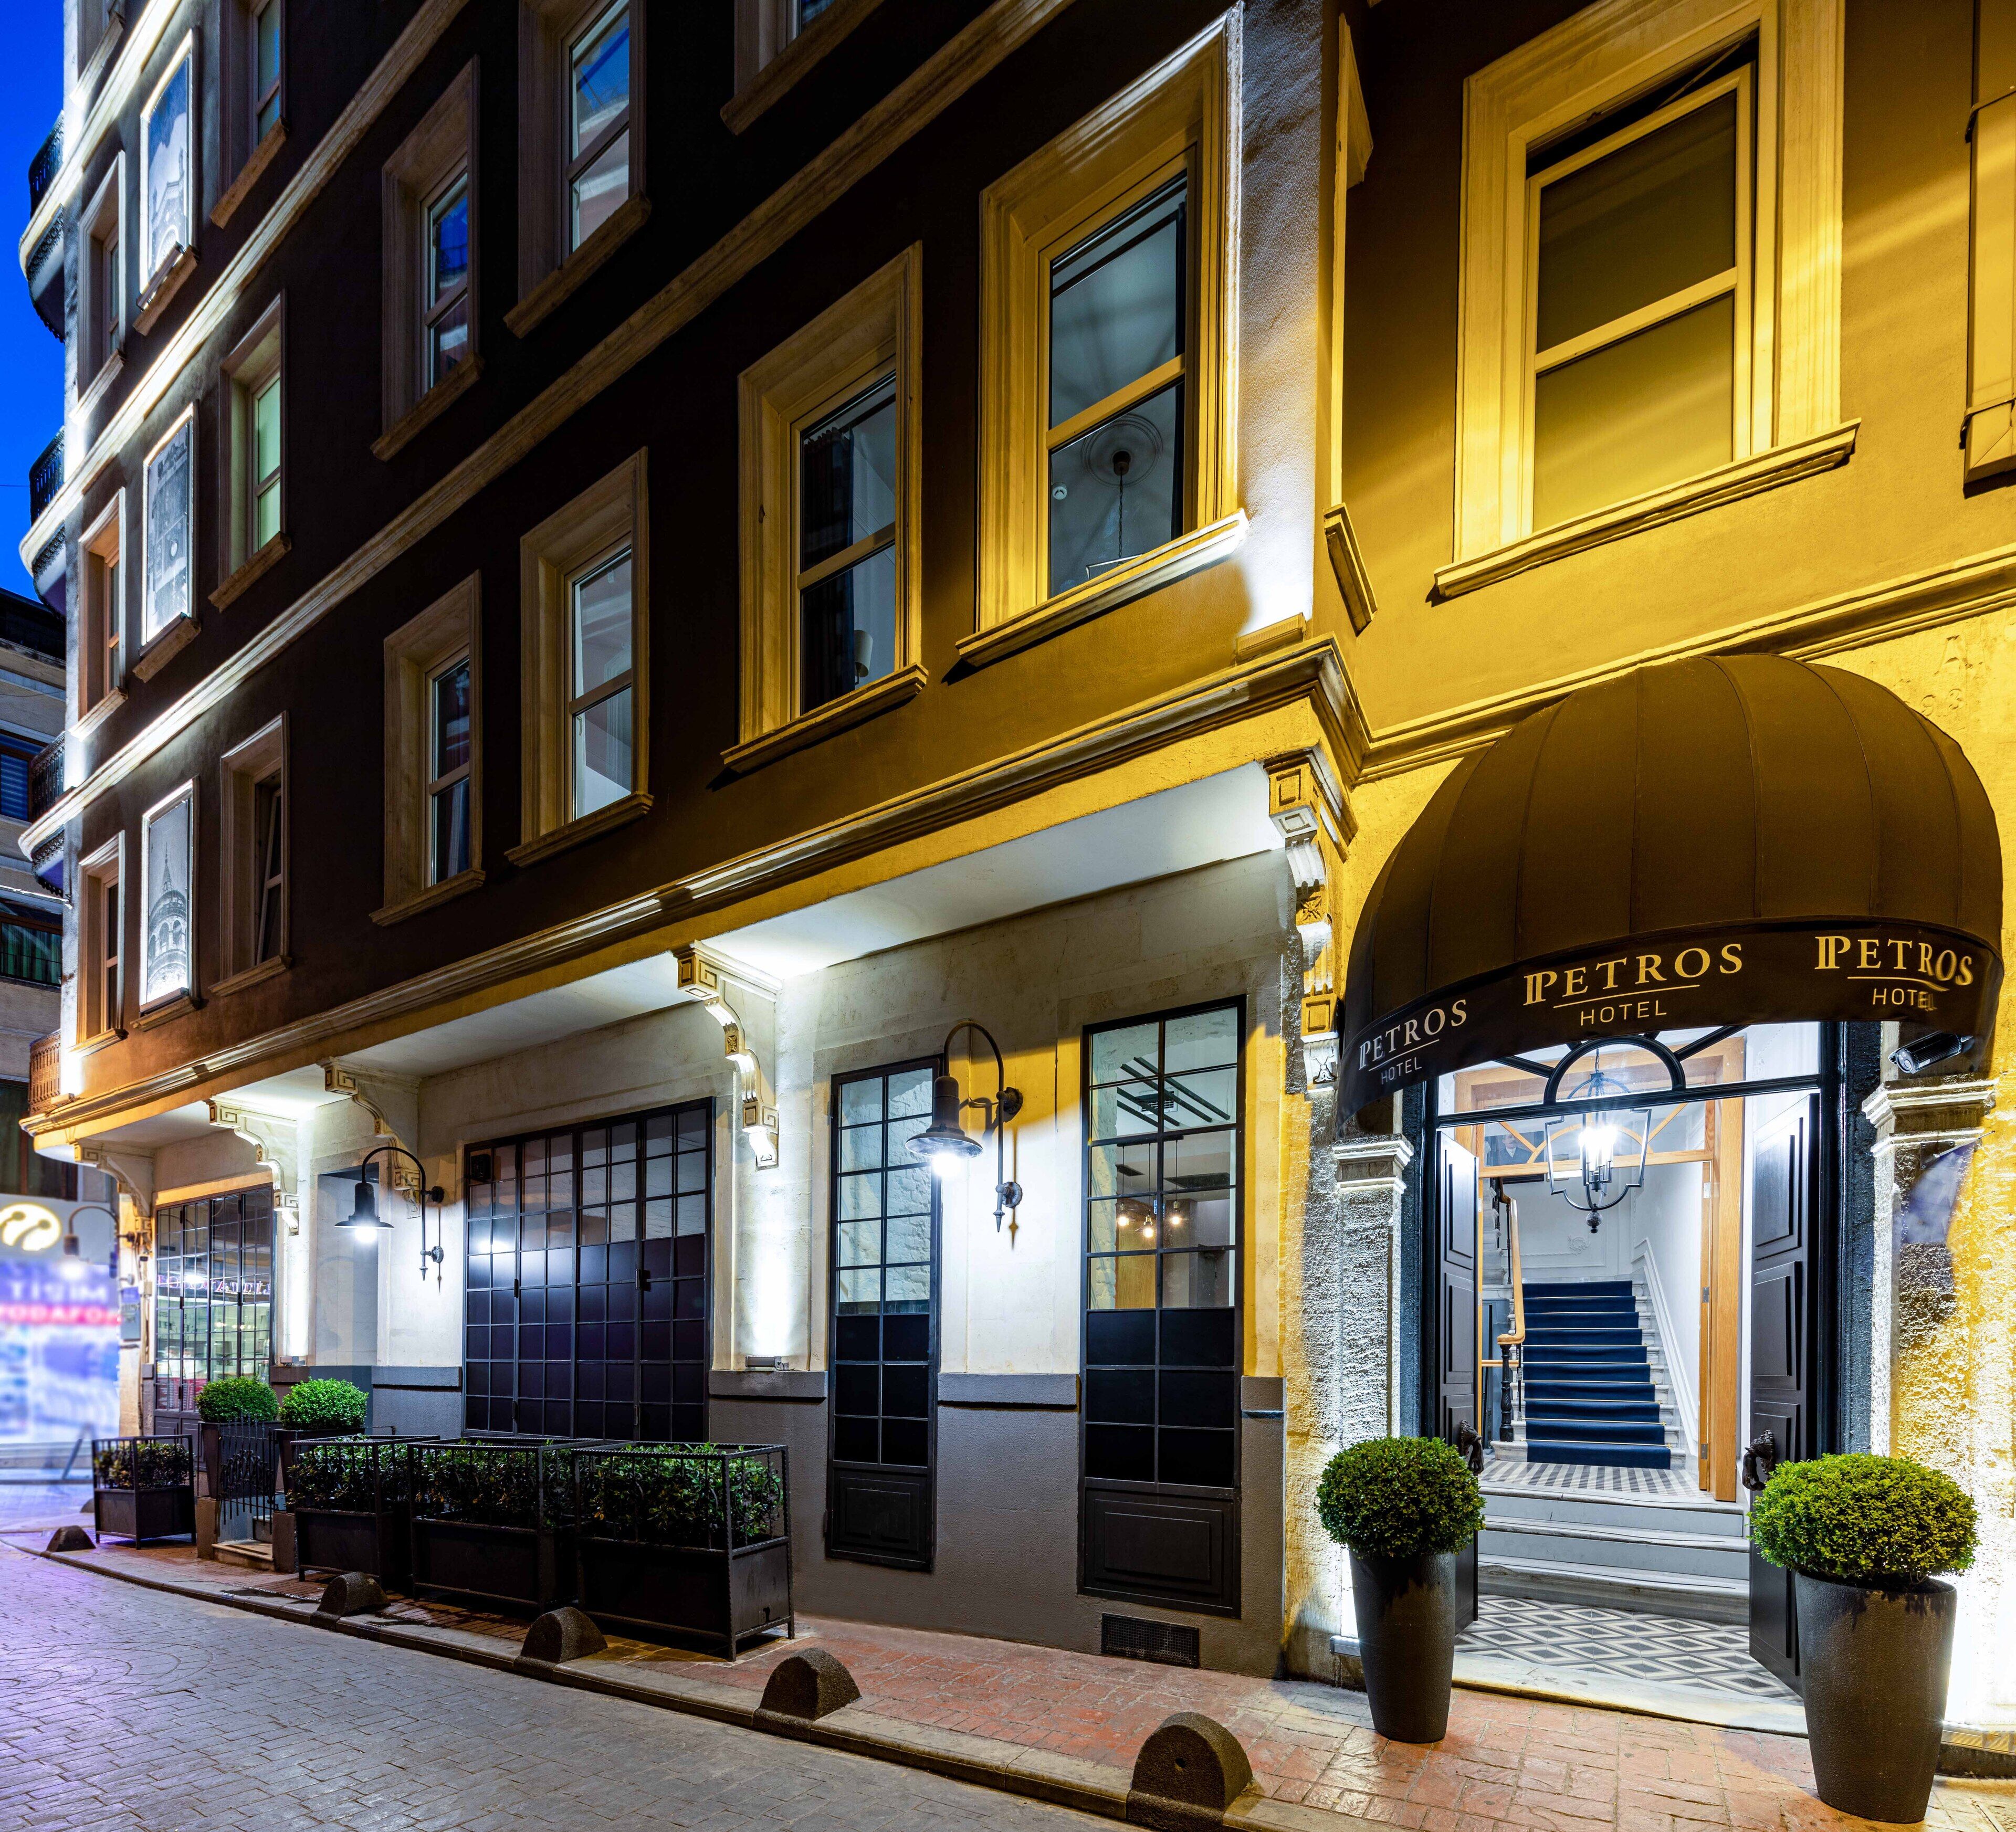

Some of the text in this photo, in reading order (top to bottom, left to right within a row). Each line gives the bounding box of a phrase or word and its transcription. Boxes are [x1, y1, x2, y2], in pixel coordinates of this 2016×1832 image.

[1523, 944, 1742, 1006] PETROS
[1814, 936, 1973, 985] PETROS
[1581, 1001, 1666, 1026] HOTEL
[1873, 988, 1937, 1012] HOTEL
[1359, 999, 1466, 1070] PETROS
[1381, 1057, 1422, 1085] HOTEL
